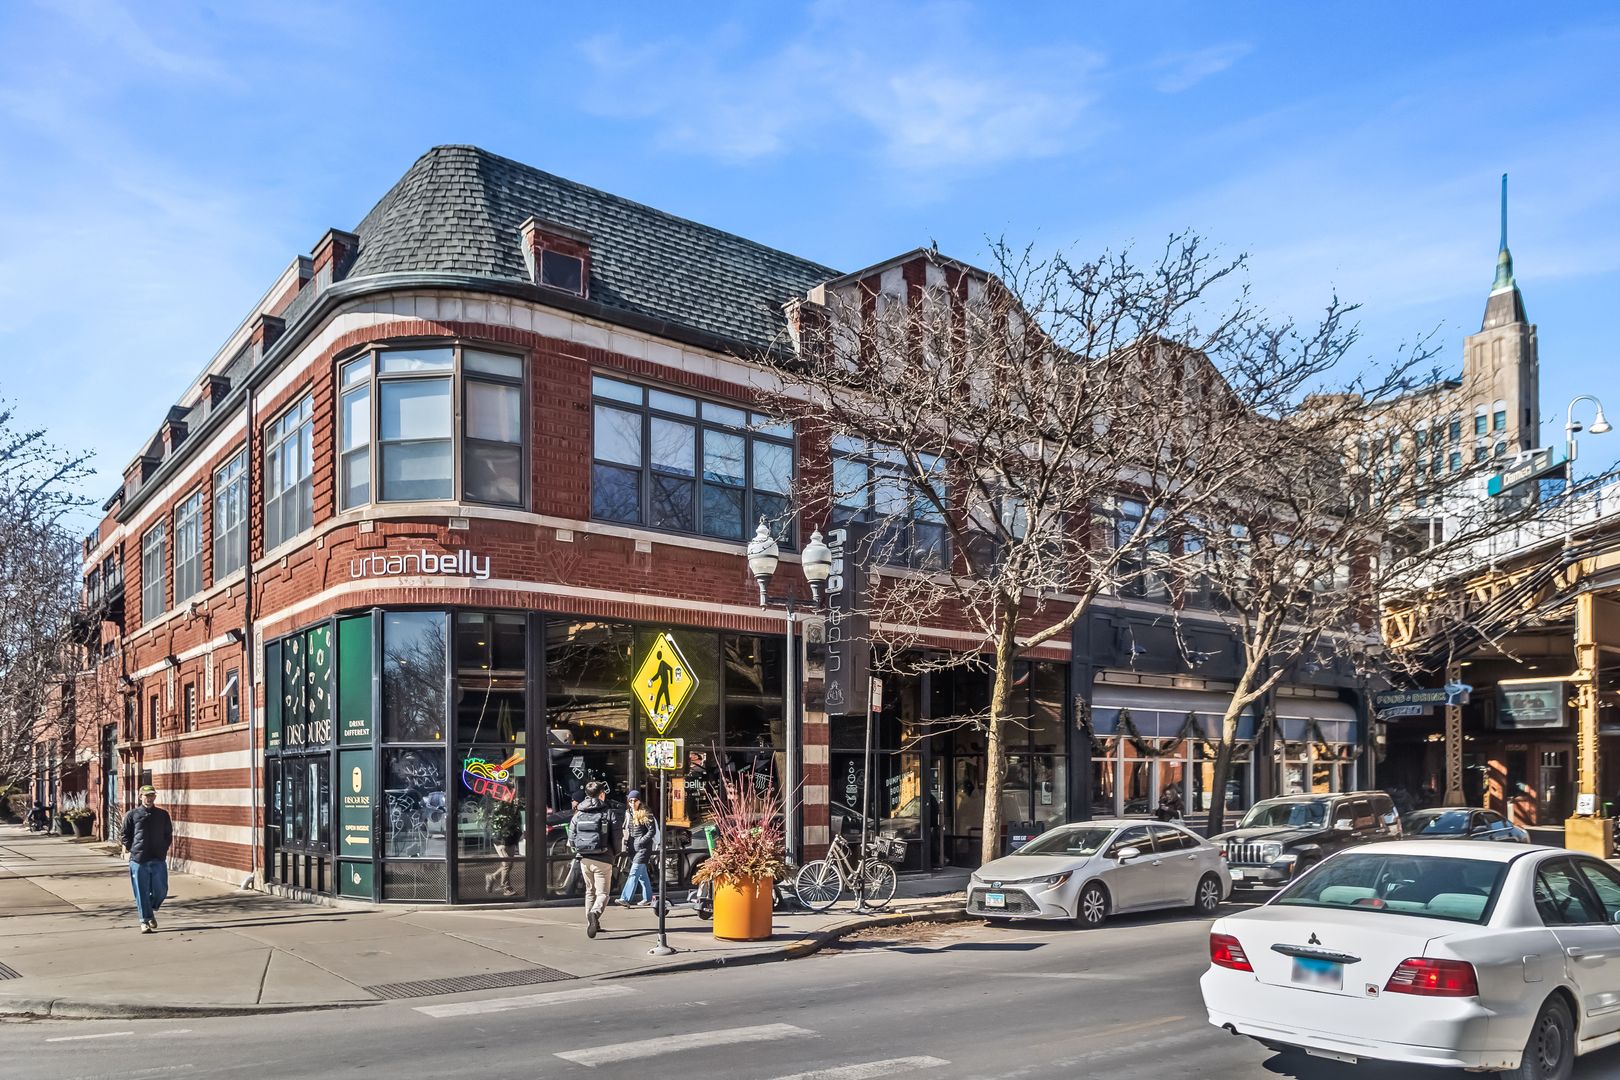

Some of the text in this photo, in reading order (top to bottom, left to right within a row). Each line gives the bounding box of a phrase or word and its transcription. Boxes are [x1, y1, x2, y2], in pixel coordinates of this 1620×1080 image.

[351, 549, 490, 579] urbanbelly
[824, 528, 847, 672] urbanbelly
[474, 777, 516, 803] OPEN
